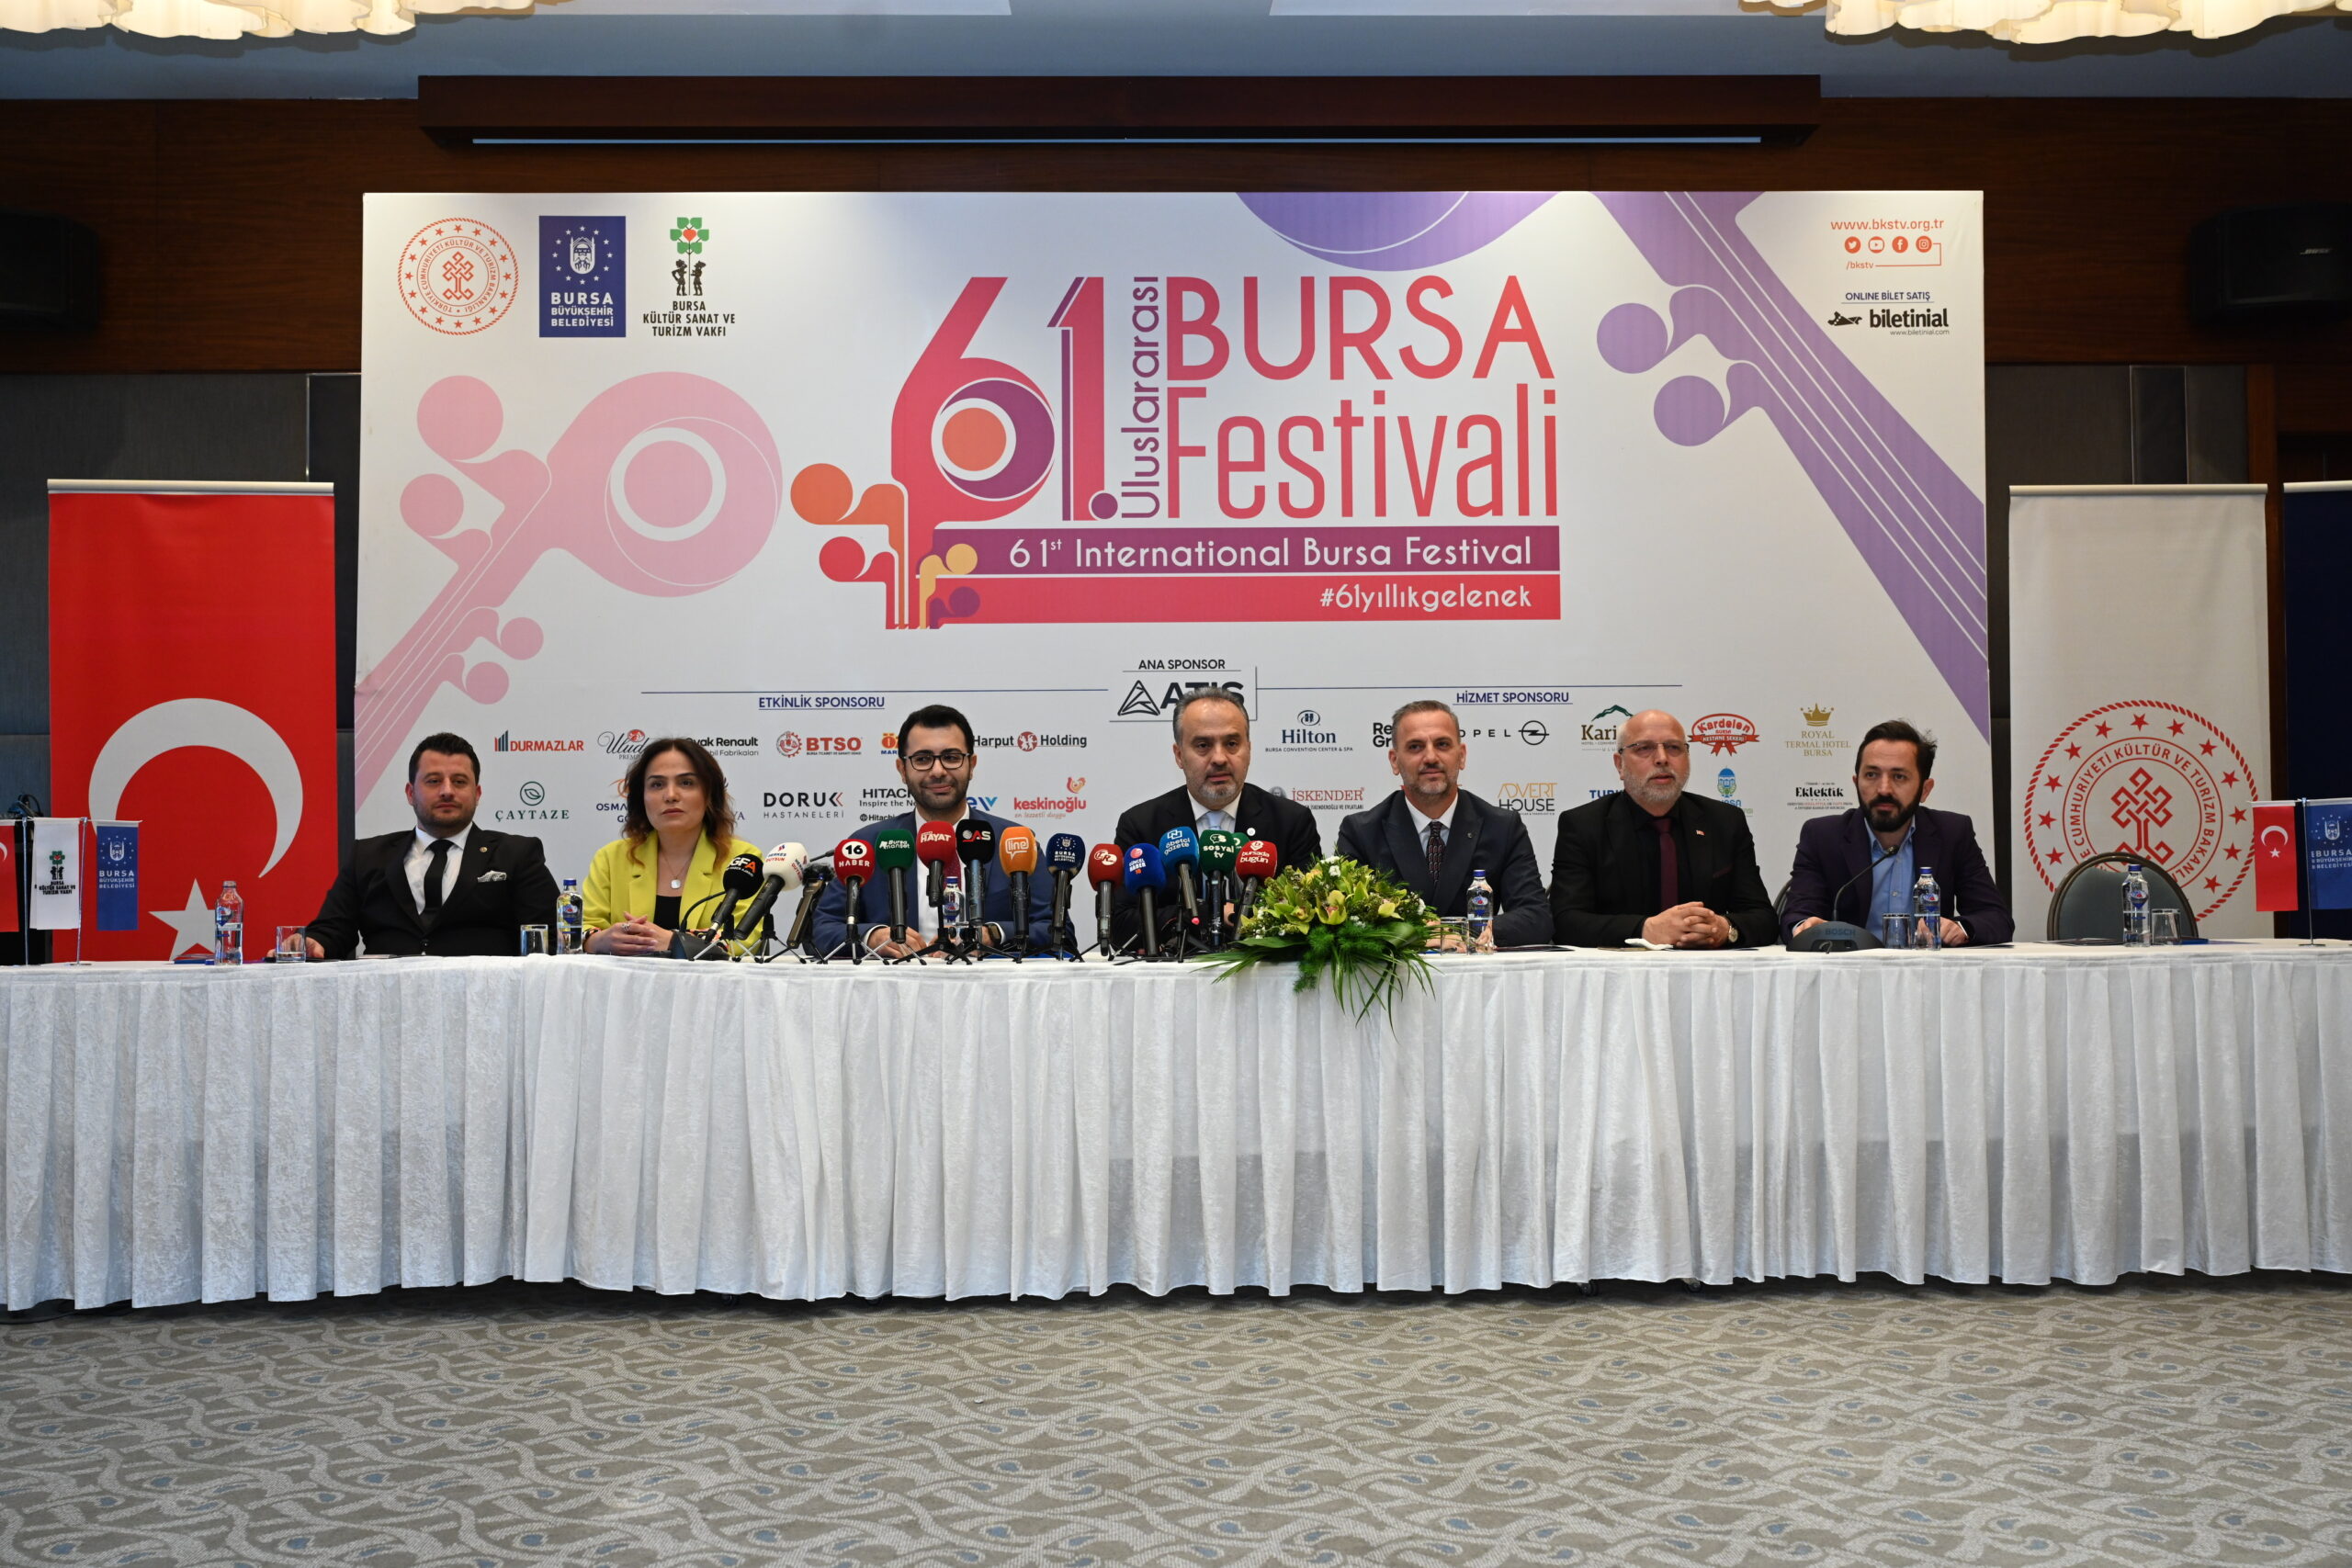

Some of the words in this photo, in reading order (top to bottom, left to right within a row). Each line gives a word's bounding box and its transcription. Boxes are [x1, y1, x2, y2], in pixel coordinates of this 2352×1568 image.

[1830, 219, 1944, 231] www.bkstv.org.tr
[445, 239, 474, 248] KÜLTÜR
[476, 244, 484, 254] VE
[483, 253, 497, 281] TURİZM
[1846, 261, 1874, 270] /bkstv
[551, 292, 614, 305] BURSA
[1845, 292, 1880, 301] ONLINE
[1882, 290, 1904, 300] BİLET
[1906, 291, 1930, 302] SATIŞ
[551, 305, 614, 317] BÜYÜKŞEHİR
[673, 300, 706, 311] BURSA
[551, 316, 614, 327] BELEDİYESİ
[643, 312, 682, 324] KÜLTÜR
[686, 313, 719, 324] SANAT
[724, 313, 735, 324] VE
[1870, 308, 1949, 328] biletinial
[652, 324, 692, 337] TURİZM
[696, 326, 726, 337] VAKFI
[1166, 275, 1556, 382] BURSA
[1121, 276, 1160, 520] Uluslararası
[1167, 383, 1558, 520] Festivali
[1076, 536, 1289, 569] International
[1305, 536, 1392, 568] Bursa
[1406, 536, 1532, 567] Festival
[1138, 659, 1165, 670] ANA
[1168, 659, 1226, 670] SPONSOR
[759, 694, 811, 708] ETKİNLİK
[815, 696, 885, 708] SPONSORU
[1456, 690, 1500, 704] HİZMET
[1502, 692, 1570, 703] SPONSORU
[1581, 724, 1617, 740] Kari
[1697, 718, 1751, 734] Kardelen
[1282, 728, 1337, 744] Hilton
[1801, 730, 1835, 739] ROYAL
[510, 739, 584, 752] DURMAZLAR
[717, 737, 759, 747] Renault
[806, 737, 862, 751] BTSO
[974, 735, 1014, 749] Harput
[1040, 735, 1087, 749] Holding
[1785, 740, 1821, 749] TERMAL
[1822, 740, 1851, 749] HOTEL
[1804, 749, 1833, 757] BURSA
[2114, 742, 2170, 761] KÜLTÜR
[2174, 756, 2191, 772] VE
[863, 788, 910, 798] HITAC
[1292, 787, 1363, 802] İSKENDER
[1498, 782, 1558, 798] ADVERT
[1795, 786, 1844, 797] Eklektik
[2189, 769, 2216, 824] TURİZM
[763, 792, 843, 807] DORUK
[859, 799, 888, 808] Inspire
[1013, 796, 1087, 813] keskinoğlu
[1498, 798, 1555, 812] HOUSE
[2070, 753, 2112, 847] CUMHURİYETİ
[495, 809, 570, 822] ÇAYTAZE
[763, 809, 844, 818] HASTANELERİ
[920, 832, 952, 843] HAYAT
[844, 844, 864, 855] 16
[1007, 839, 1028, 852] line
[2174, 827, 2215, 883] BAKANLI
[2315, 849, 2352, 858] BURSA
[838, 859, 871, 868] HABER
